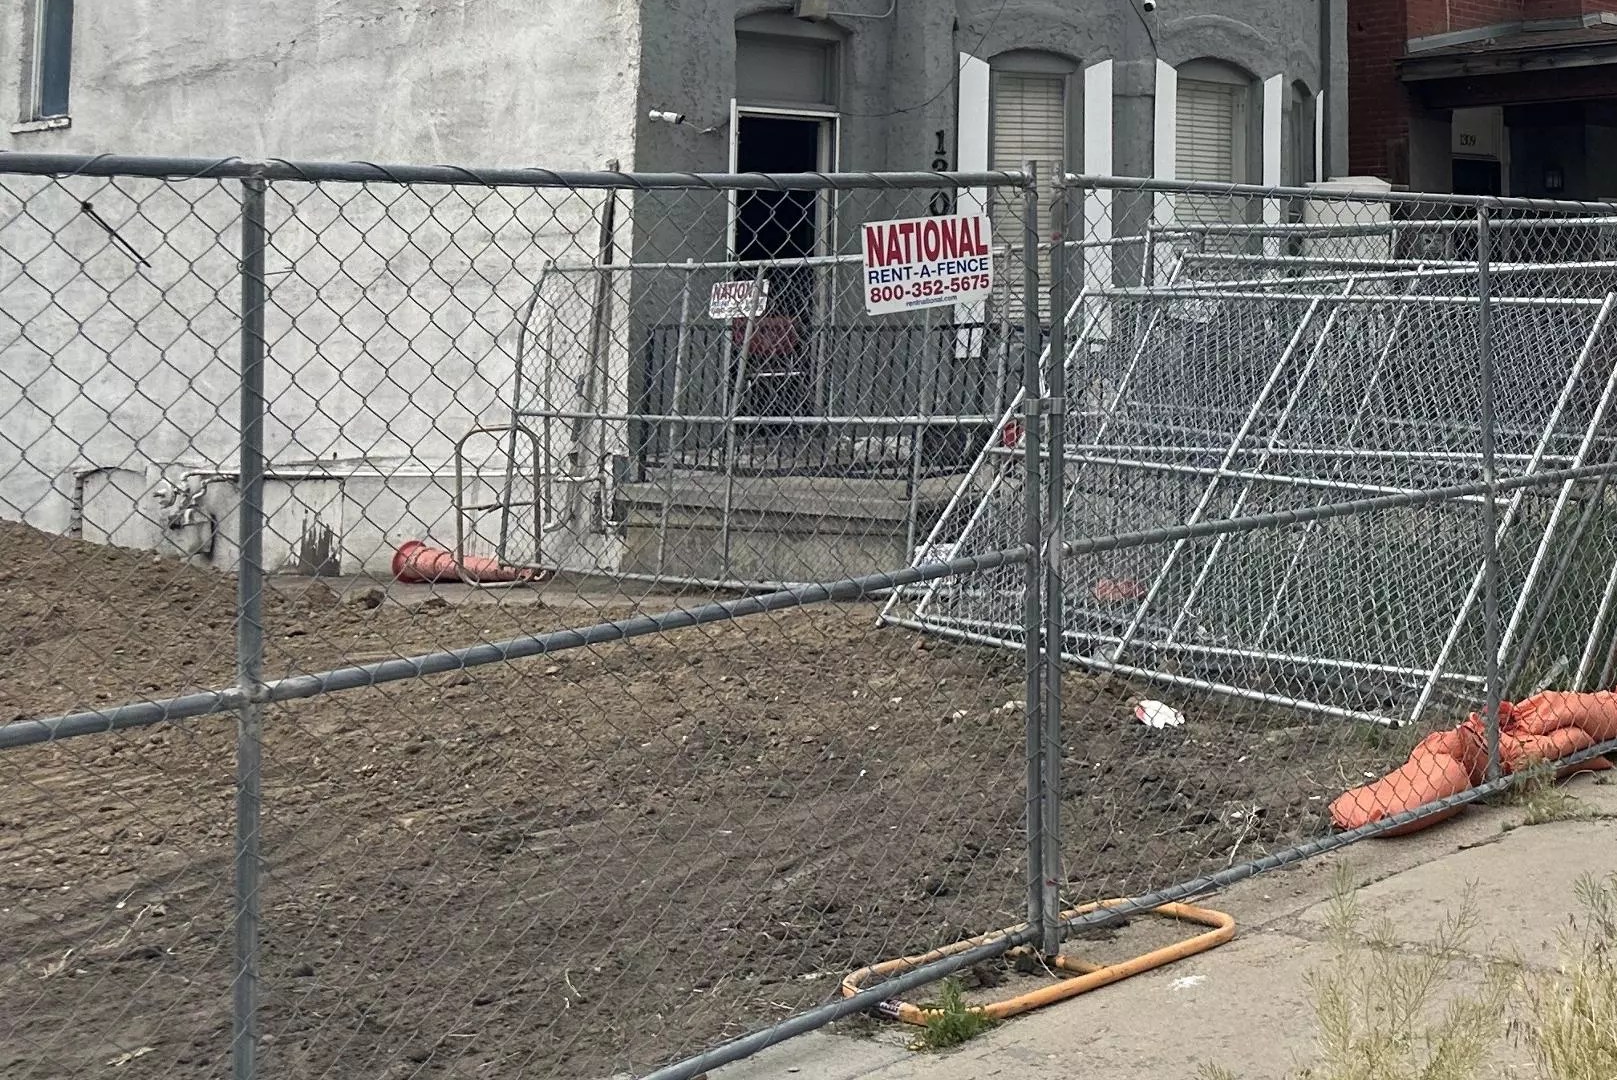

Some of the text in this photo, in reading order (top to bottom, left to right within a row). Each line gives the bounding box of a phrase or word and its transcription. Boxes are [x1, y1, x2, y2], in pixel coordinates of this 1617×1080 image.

[866, 216, 988, 268] NATIONAL
[868, 258, 989, 284] RENT-A-FENCE
[870, 274, 989, 303] 800-352-5675
